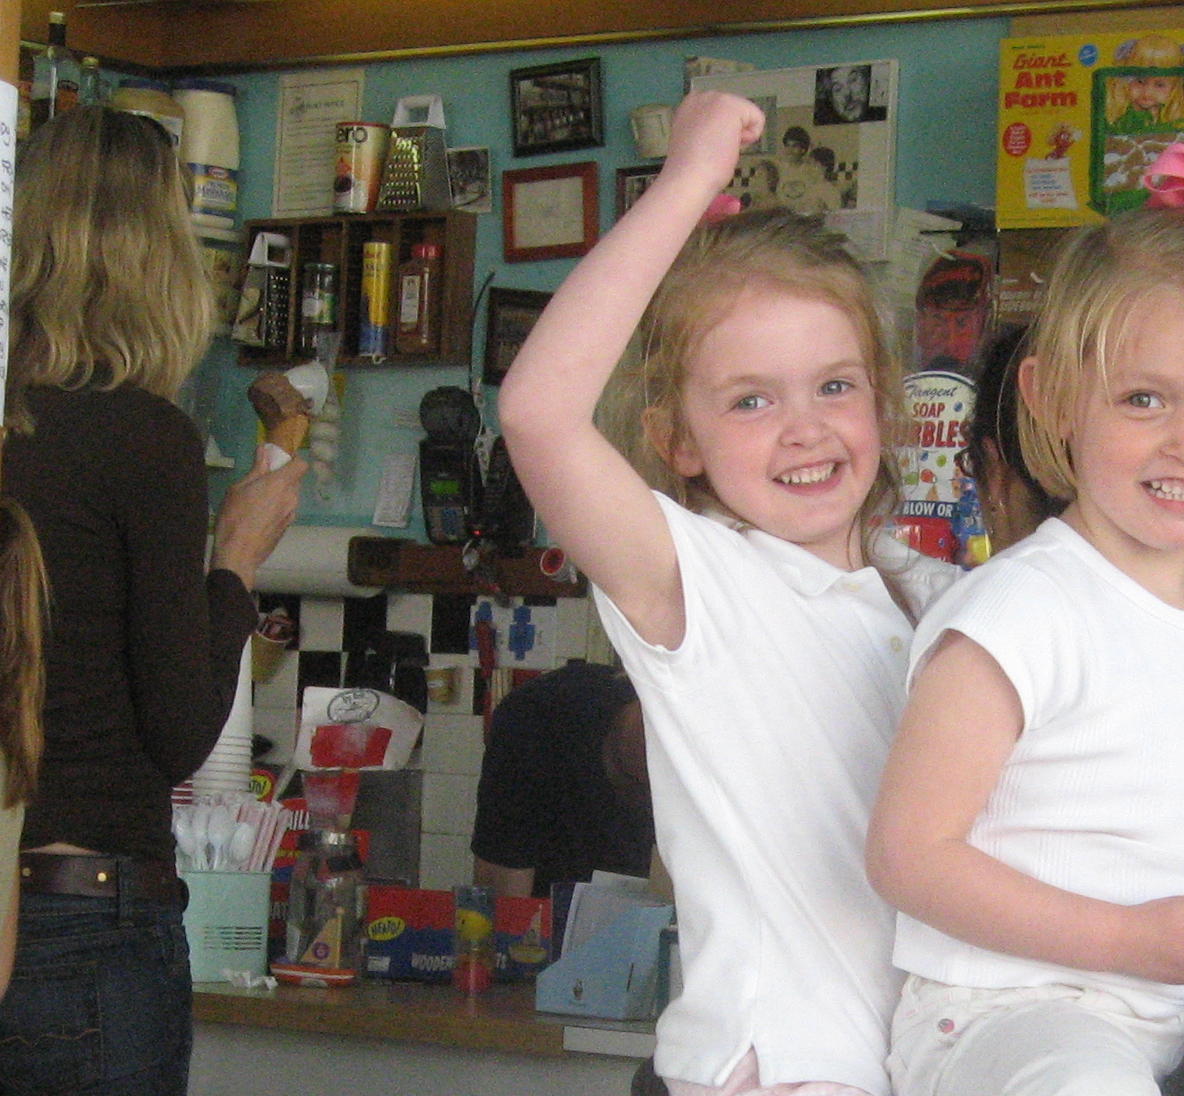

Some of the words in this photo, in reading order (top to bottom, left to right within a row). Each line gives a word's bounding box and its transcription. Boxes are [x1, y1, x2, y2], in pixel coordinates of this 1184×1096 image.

[1013, 53, 1072, 70] Giant
[1015, 71, 1066, 88] Ant
[1004, 91, 1078, 109] Farm
[913, 402, 945, 418] SOAP
[903, 502, 933, 517] BLOW
[937, 503, 954, 517] OR
